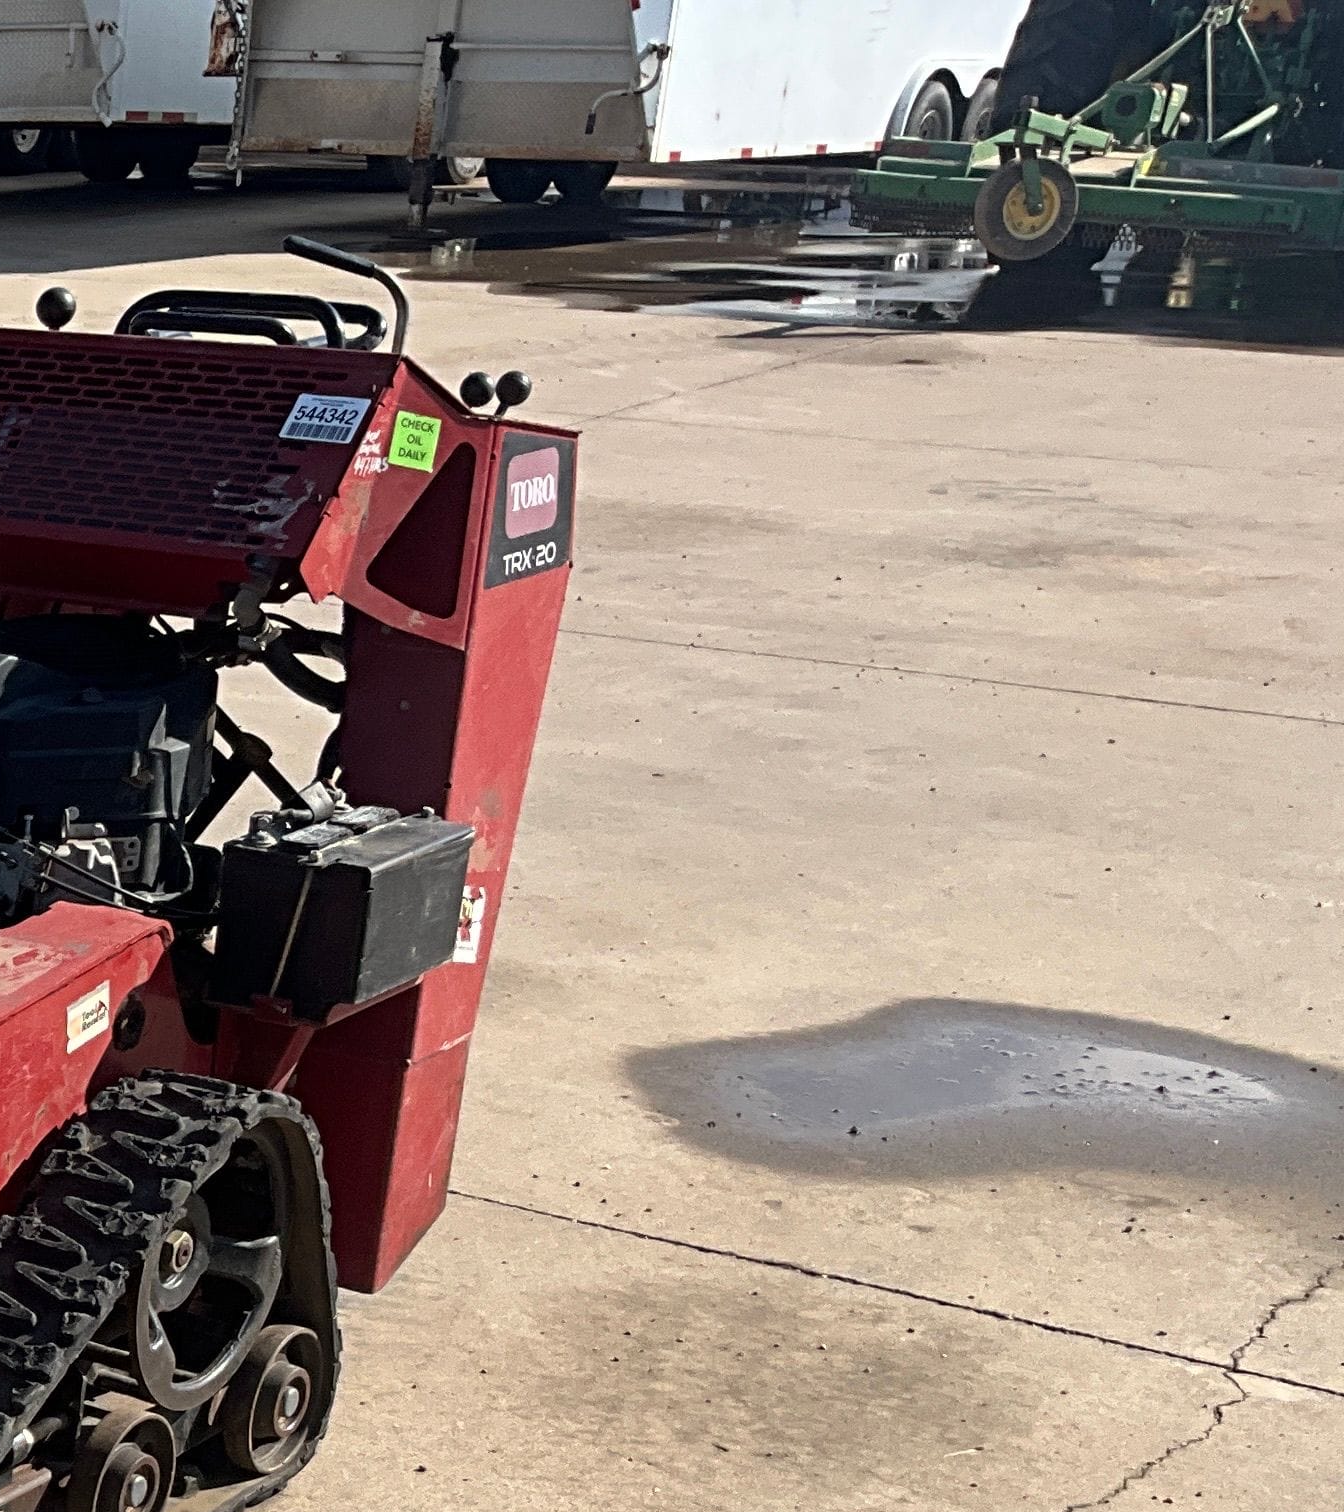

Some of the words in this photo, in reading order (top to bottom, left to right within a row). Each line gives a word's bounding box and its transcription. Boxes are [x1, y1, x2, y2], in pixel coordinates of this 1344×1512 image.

[294, 405, 359, 426] 544342
[401, 417, 435, 434] CHECK
[406, 433, 424, 446] OIL
[398, 447, 428, 463] DAILY
[510, 473, 555, 512] TORO
